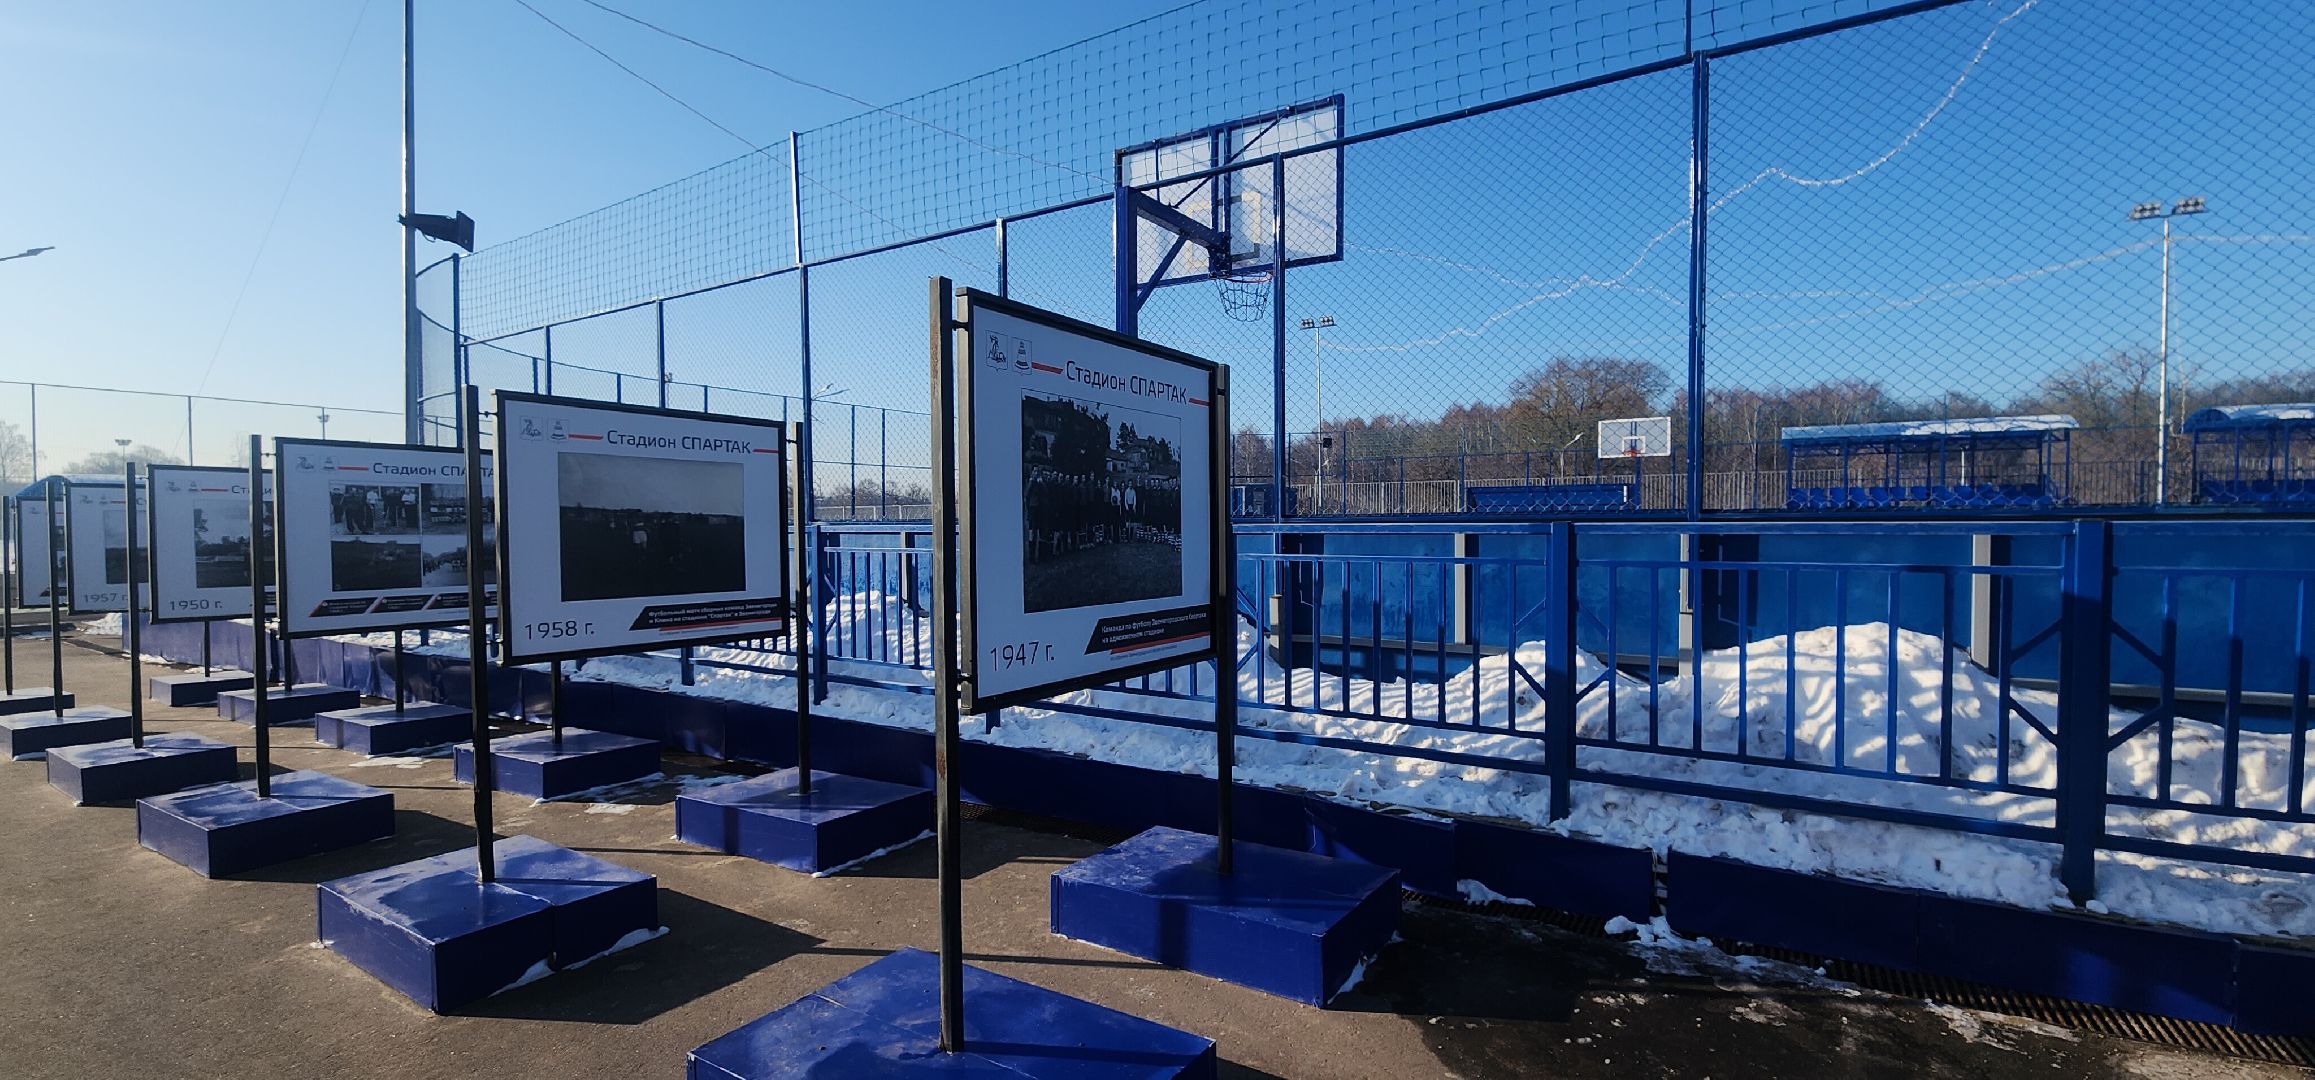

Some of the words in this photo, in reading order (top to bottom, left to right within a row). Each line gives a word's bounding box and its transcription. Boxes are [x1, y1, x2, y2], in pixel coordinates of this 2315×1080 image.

[1066, 360, 1126, 392] Стадион
[1130, 375, 1188, 405] СПАРТАК
[607, 429, 677, 449] Стадион
[681, 436, 751, 454] СПАРТАК
[373, 462, 437, 476] Стадион
[440, 465, 494, 478] СПТА
[84, 592, 117, 603] 1957
[169, 600, 210, 611] 1950
[214, 601, 223, 609] г.
[524, 620, 578, 640] 1958
[585, 622, 595, 635] г.
[1101, 624, 1125, 634] Команда
[990, 641, 1039, 672] 1947
[1045, 644, 1055, 662] г.
